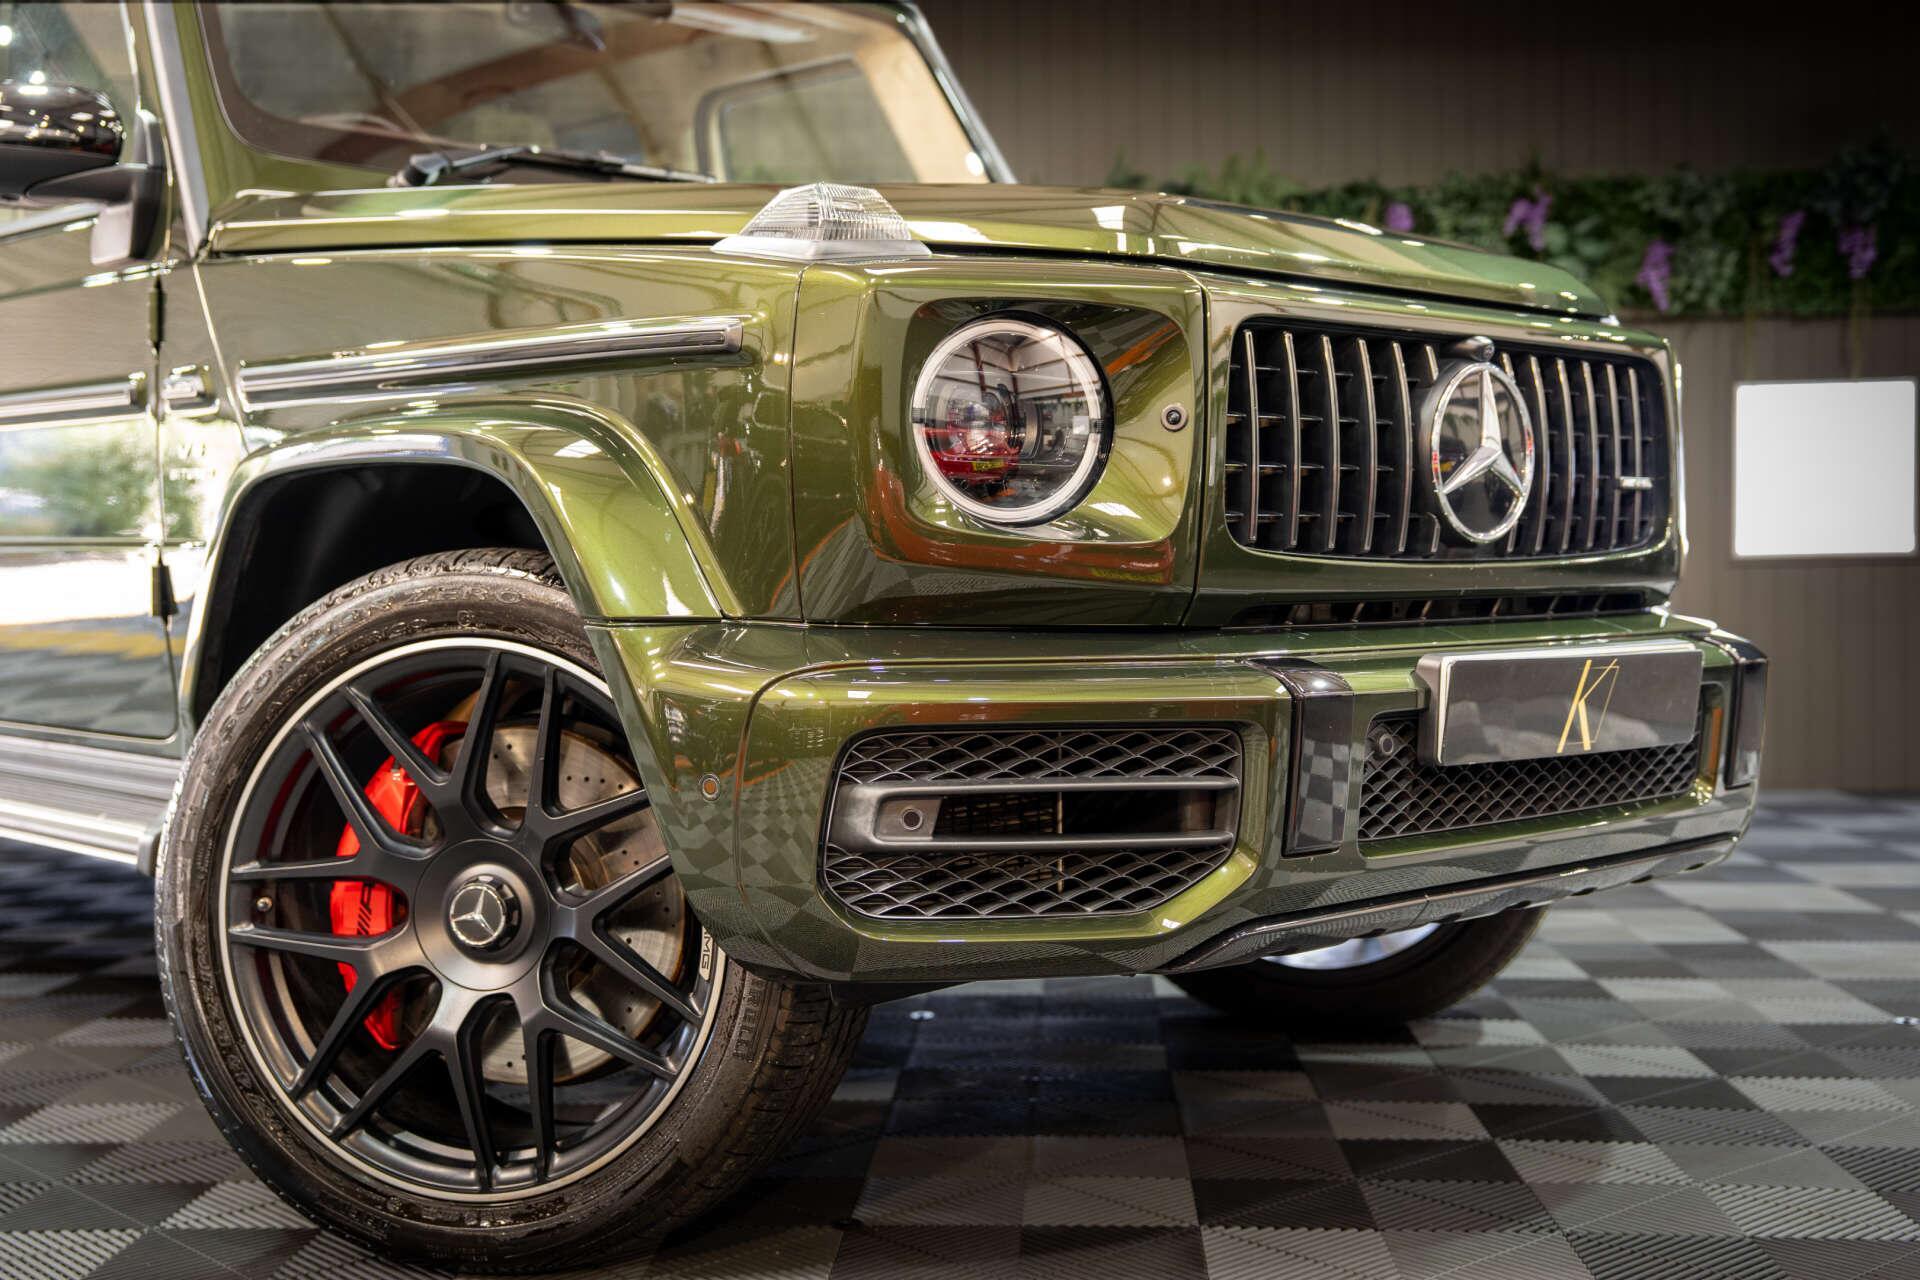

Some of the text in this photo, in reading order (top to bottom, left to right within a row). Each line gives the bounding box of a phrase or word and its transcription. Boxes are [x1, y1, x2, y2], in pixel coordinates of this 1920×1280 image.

[1557, 658, 1619, 754] K
[701, 931, 711, 969] MG
[732, 977, 766, 1061] IRELLI
